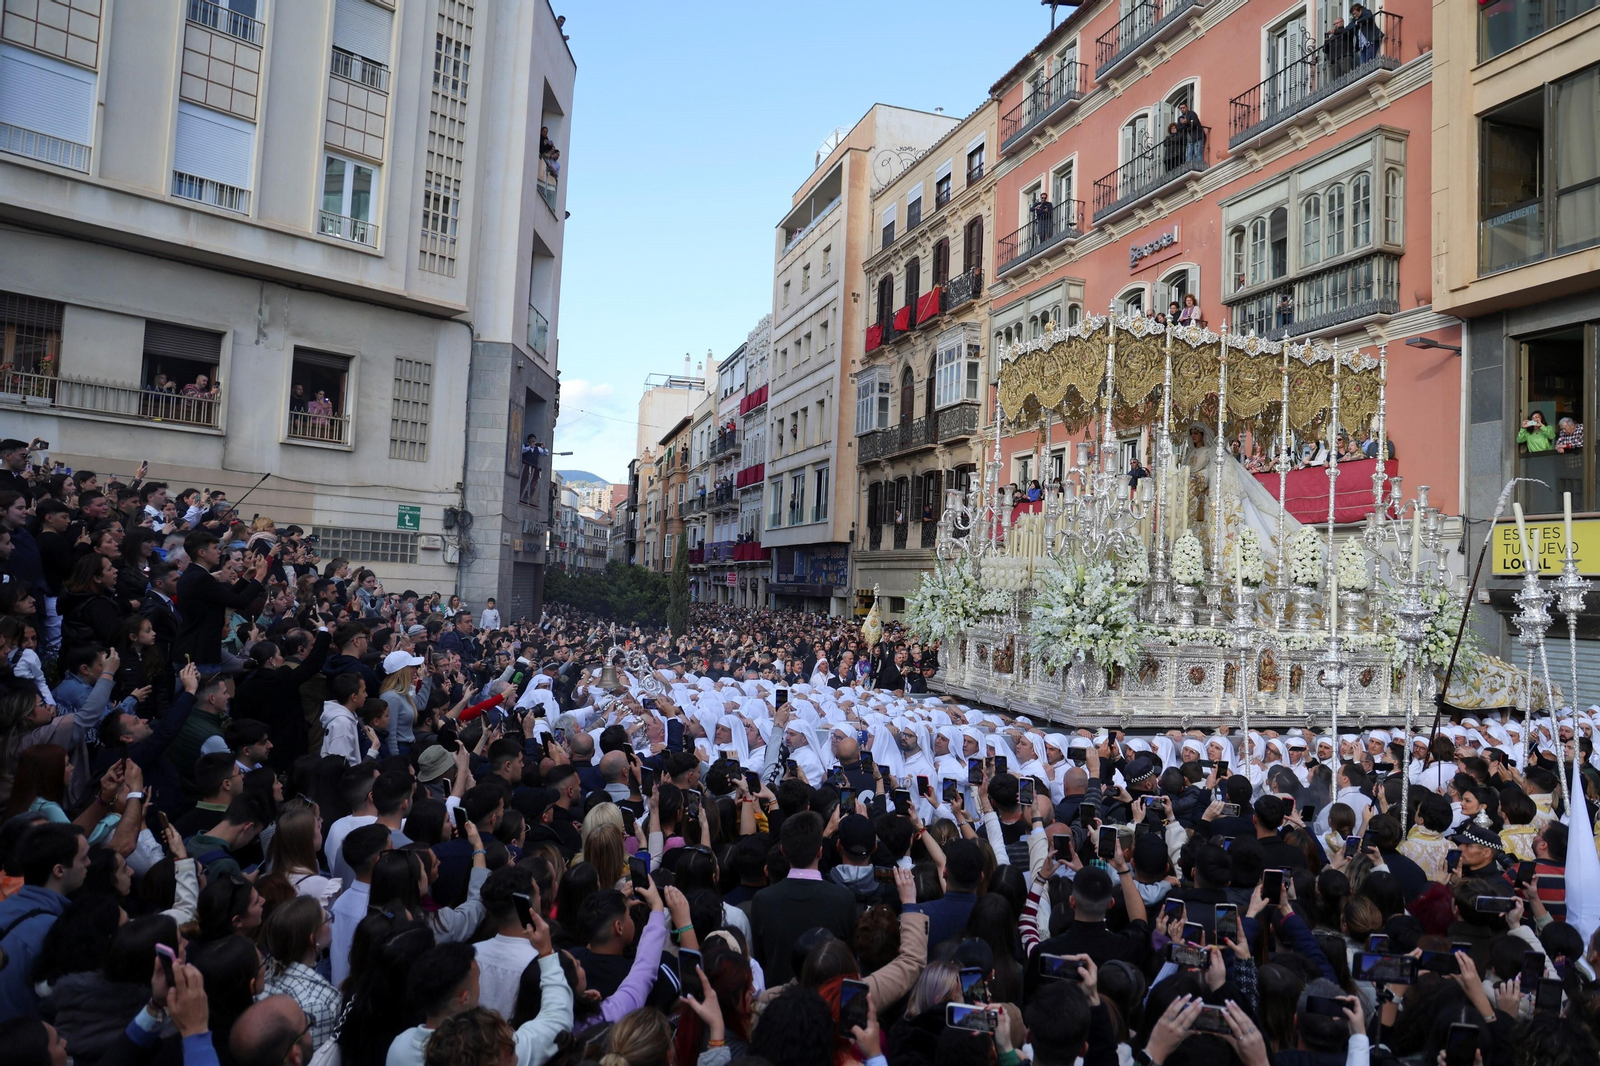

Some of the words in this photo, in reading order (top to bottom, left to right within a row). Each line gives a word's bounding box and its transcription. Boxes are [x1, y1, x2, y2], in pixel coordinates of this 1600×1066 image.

[1487, 204, 1537, 228] BLANQUEAMIENTO
[1129, 225, 1179, 262] Sercotel
[1543, 527, 1561, 539] ES
[1503, 543, 1521, 555] TU
